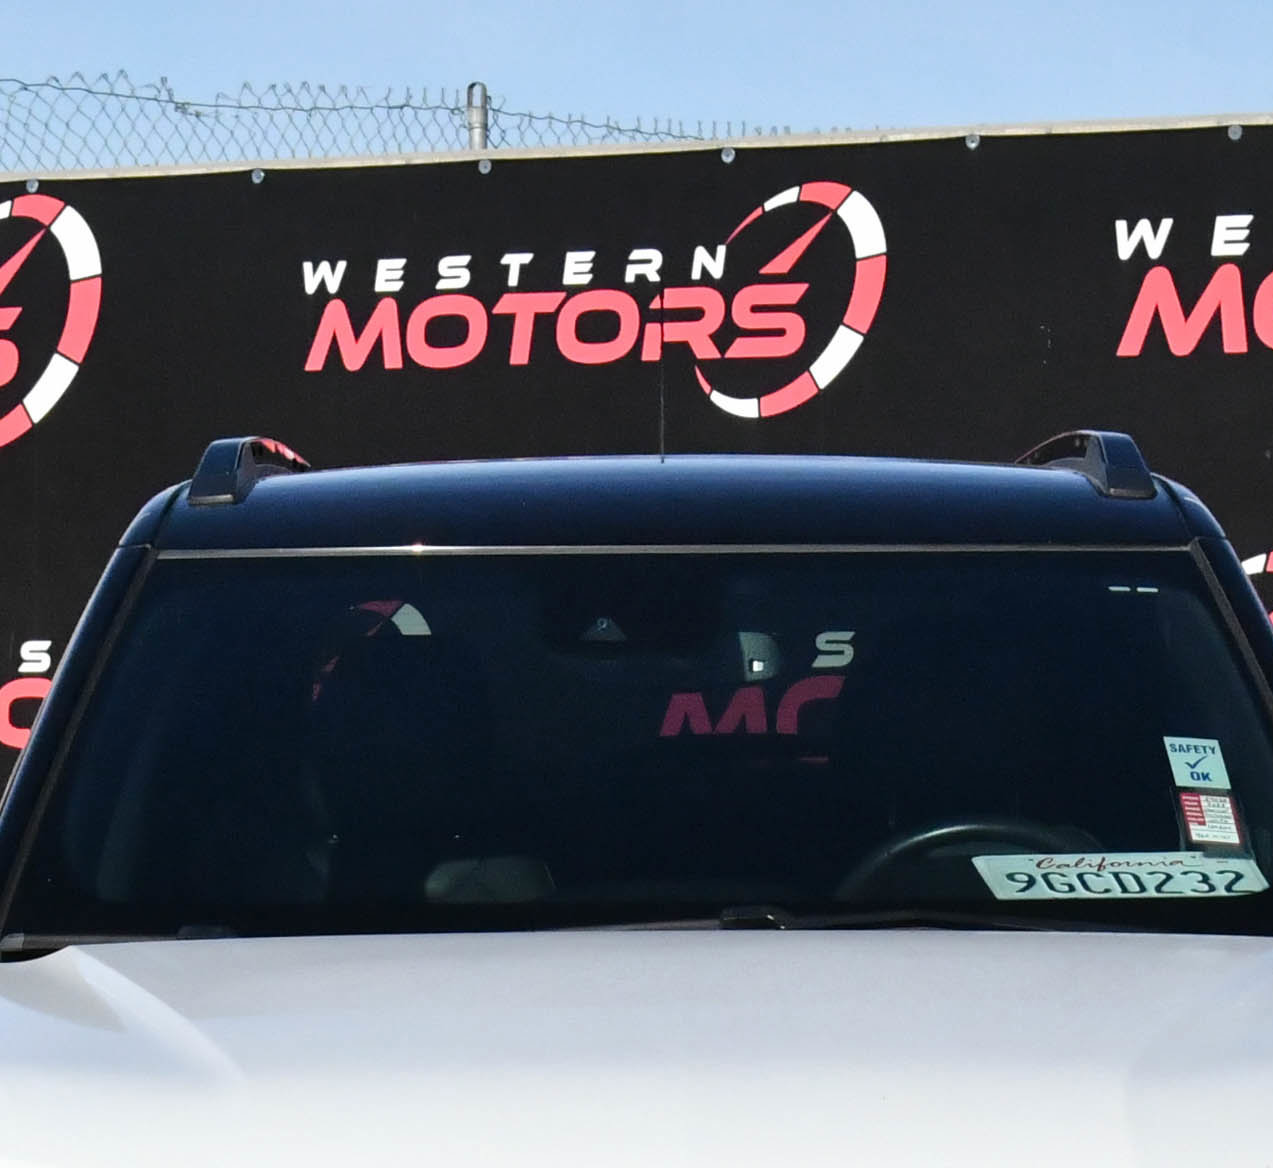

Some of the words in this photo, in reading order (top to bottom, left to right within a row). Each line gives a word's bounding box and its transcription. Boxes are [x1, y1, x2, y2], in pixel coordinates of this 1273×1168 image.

[303, 245, 727, 295] WESTERN
[304, 281, 810, 373] MOTORS
[1169, 743, 1217, 755] SAFETY
[1190, 771, 1213, 783] OK
[1035, 856, 1186, 872] California
[1005, 870, 1249, 895] 9GCD232
